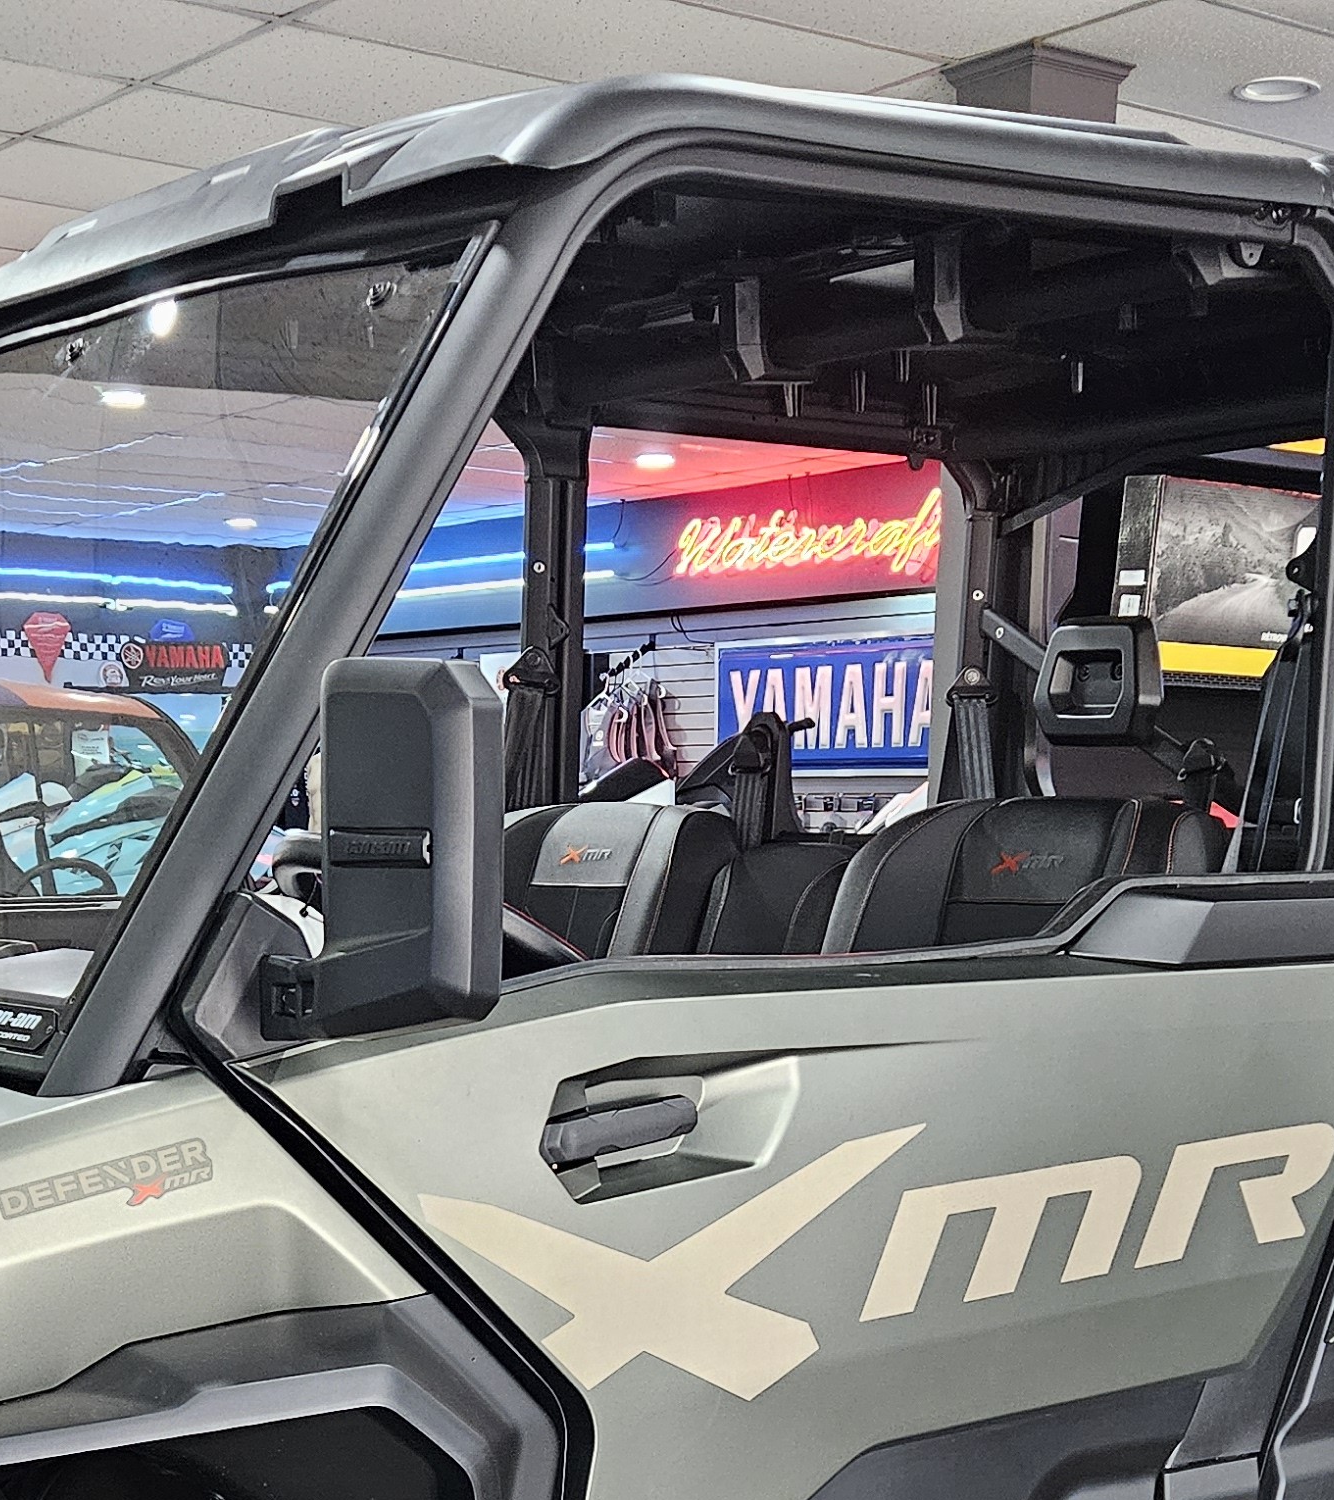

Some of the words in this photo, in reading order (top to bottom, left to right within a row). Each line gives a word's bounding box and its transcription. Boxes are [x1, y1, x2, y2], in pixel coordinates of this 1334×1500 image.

[674, 488, 942, 575] Watercraf
[145, 644, 225, 670] YAMAHA
[729, 660, 935, 750] YAMAHA
[0, 1139, 207, 1217] DEFENDER
